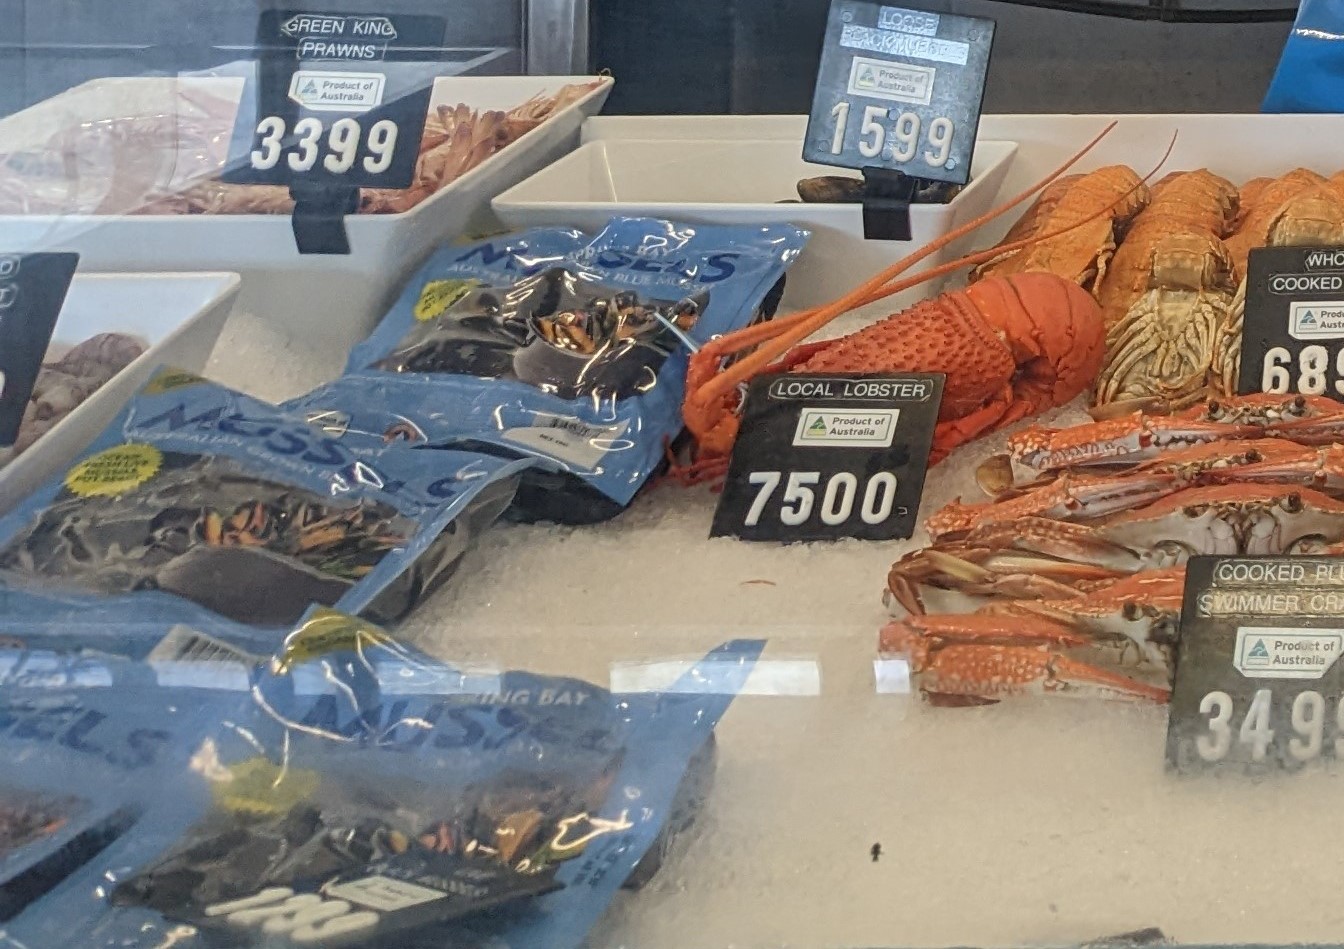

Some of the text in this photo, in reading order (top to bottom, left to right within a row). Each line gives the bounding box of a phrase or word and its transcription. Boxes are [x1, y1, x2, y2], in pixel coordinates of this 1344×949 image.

[286, 18, 397, 36] GREEN KING
[301, 42, 376, 59] PRAWNS
[879, 69, 925, 83] Product of
[322, 80, 374, 91] Product of
[877, 81, 916, 93] Australia
[320, 92, 364, 102] Australia
[831, 102, 954, 167] 1599
[251, 116, 398, 174] 3399
[1273, 277, 1343, 291] COOKED
[777, 382, 926, 398] LOCAL LOBSTER
[832, 417, 886, 426] Product of
[829, 427, 876, 437] Australia
[744, 471, 898, 526] 7500
[1219, 563, 1305, 582] COOKED
[1200, 594, 1300, 611] SWIMMER
[1275, 640, 1335, 651] Product of
[1272, 654, 1326, 666] Australia
